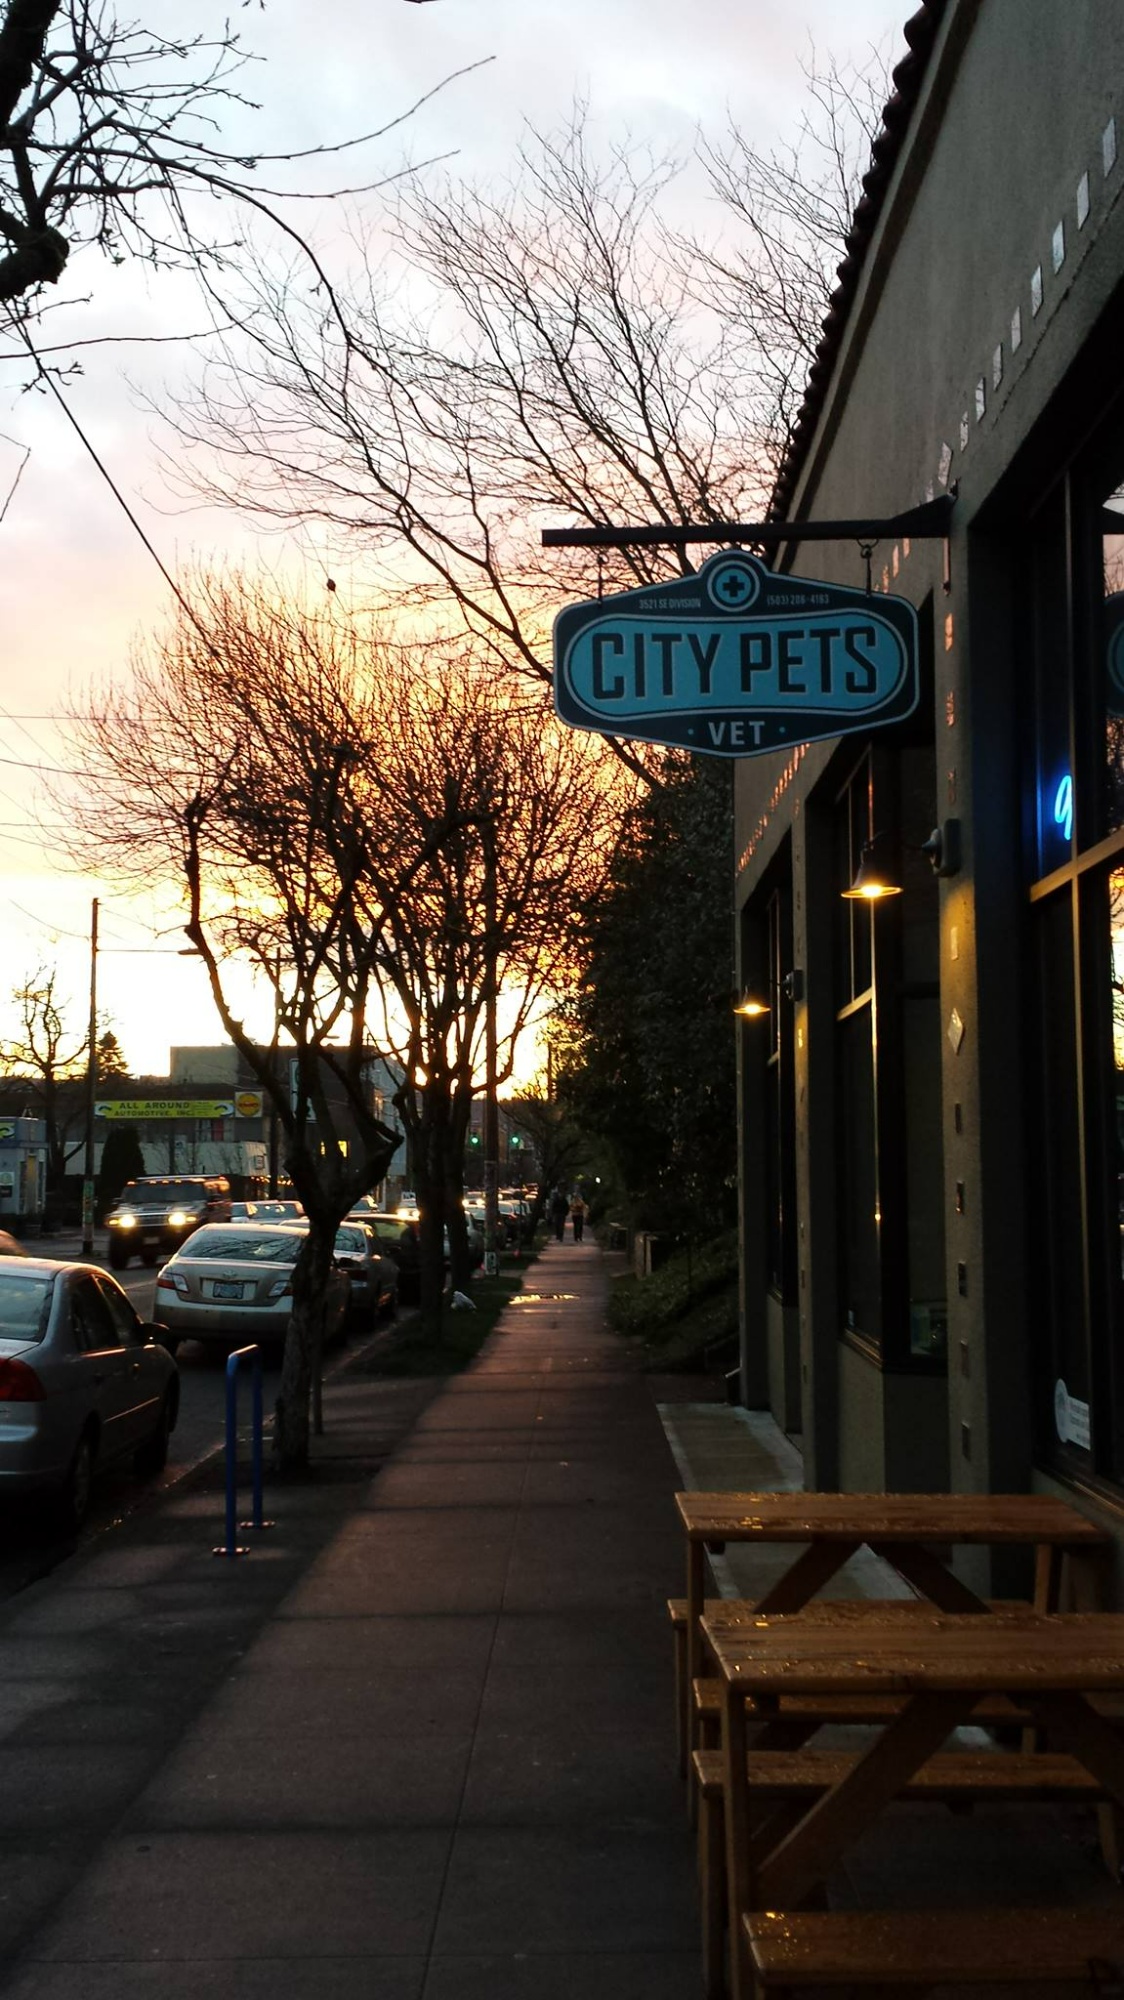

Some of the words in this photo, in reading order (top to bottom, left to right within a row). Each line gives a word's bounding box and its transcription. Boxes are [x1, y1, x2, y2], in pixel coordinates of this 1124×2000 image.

[639, 598, 657, 610] 3521
[658, 598, 668, 610] SE
[669, 597, 702, 609] DIVISION
[591, 631, 722, 701] CITY
[739, 625, 879, 696] PETS
[708, 720, 766, 747] VET
[119, 1101, 139, 1110] ALL
[144, 1101, 190, 1110] AROUND
